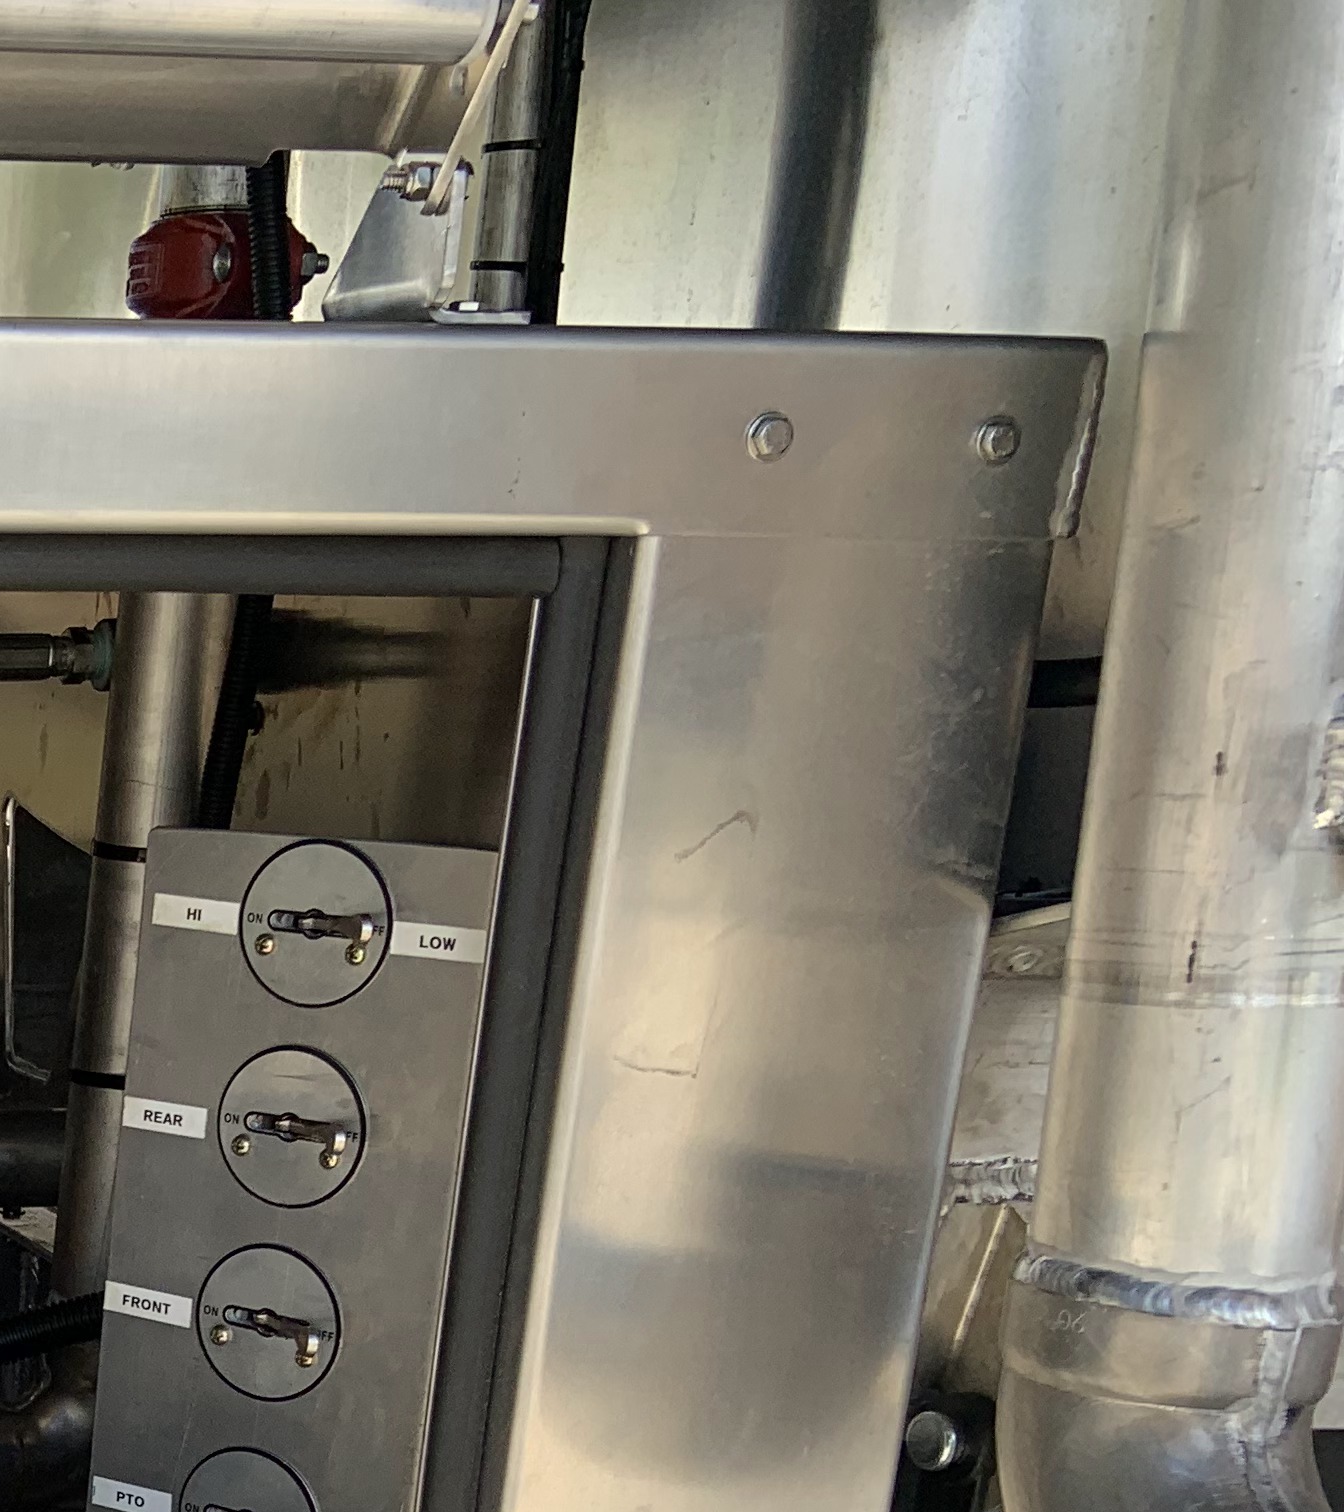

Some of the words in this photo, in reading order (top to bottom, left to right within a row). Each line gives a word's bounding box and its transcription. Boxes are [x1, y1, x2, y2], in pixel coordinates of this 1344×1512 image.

[186, 907, 202, 922] HI
[247, 912, 263, 924] ON
[372, 924, 385, 936] FF
[418, 935, 457, 951] LOW
[143, 1109, 183, 1127] REAR
[224, 1112, 240, 1124] ON
[345, 1131, 358, 1143] FF
[122, 1294, 172, 1315] FRONT
[203, 1305, 219, 1317] ON
[116, 1491, 145, 1507] PTO
